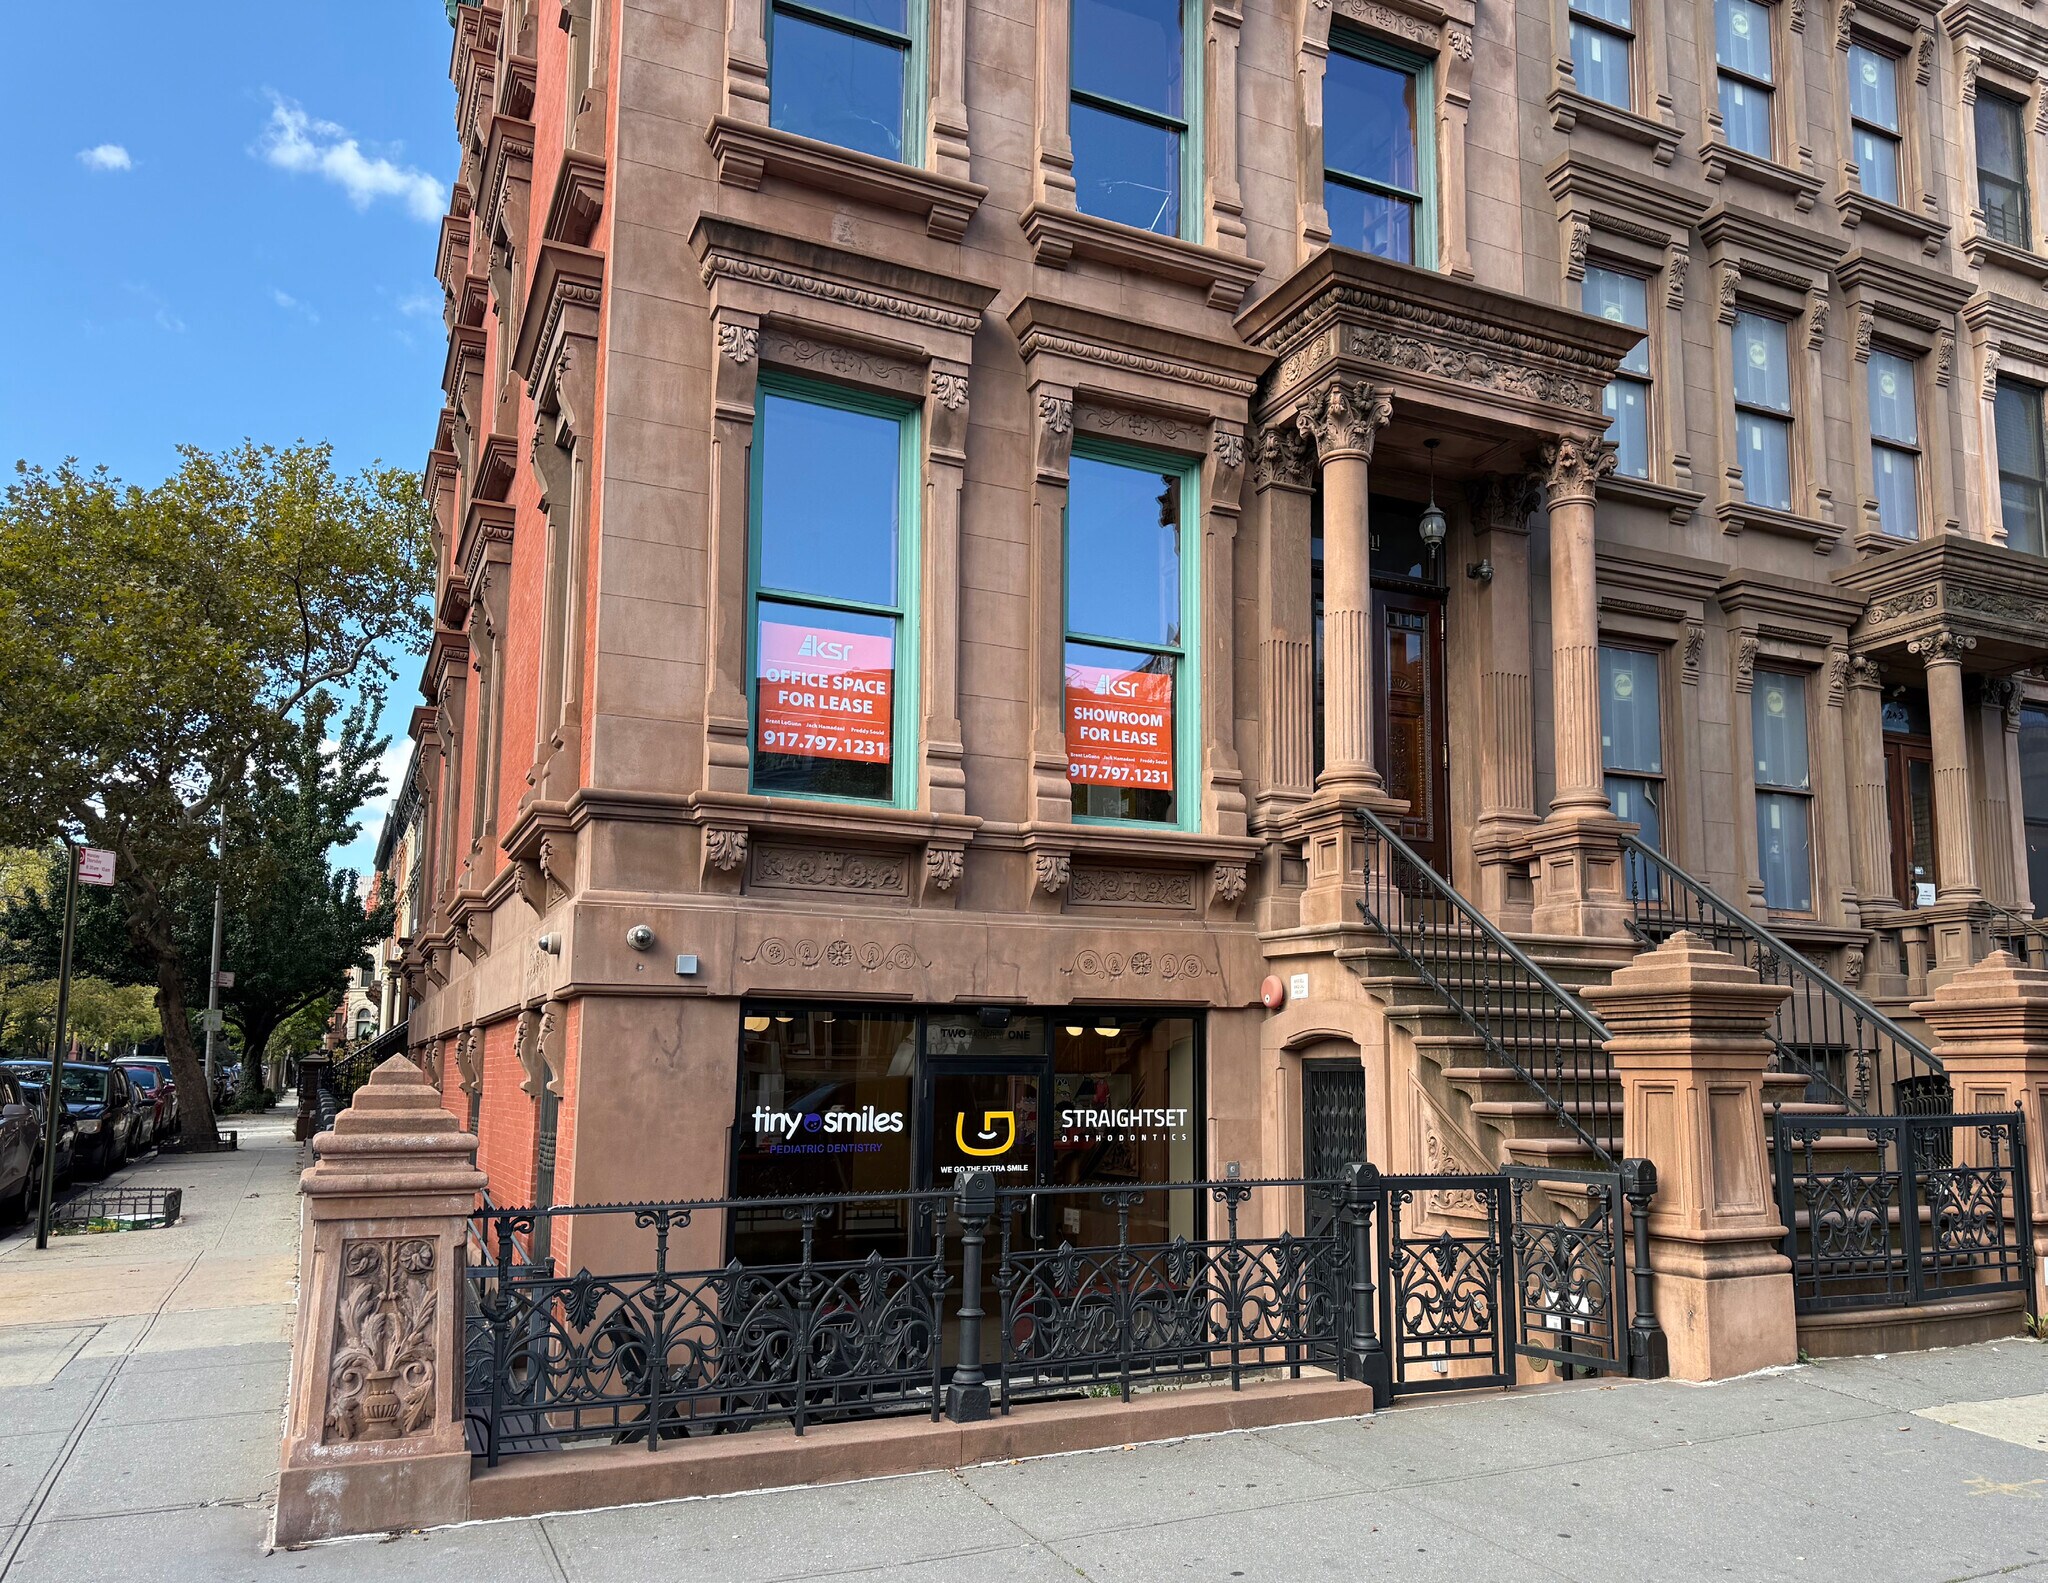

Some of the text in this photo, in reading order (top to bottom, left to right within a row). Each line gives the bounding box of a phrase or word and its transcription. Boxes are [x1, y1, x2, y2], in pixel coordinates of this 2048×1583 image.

[766, 668, 886, 695] OFFICE SPACE
[778, 690, 873, 714] FOR LEASE
[1074, 706, 1163, 727] SHOWROOM
[763, 730, 885, 756] 917.797.1231
[1080, 726, 1158, 745] FOR LEASE
[1070, 763, 1168, 784] 917.797.1231
[941, 1028, 966, 1038] TWO
[1008, 1030, 1031, 1040] ONE
[752, 1105, 903, 1140] tiny smiles
[1062, 1109, 1187, 1128] STRAIGHTSET
[1061, 1133, 1187, 1143] ORTHODONTICS
[769, 1143, 883, 1154] PEDIATRIC DENTISTRY
[940, 1166, 952, 1174] WE
[982, 1164, 1006, 1172] EXTRA
[1006, 1164, 1029, 1172] SMILE
